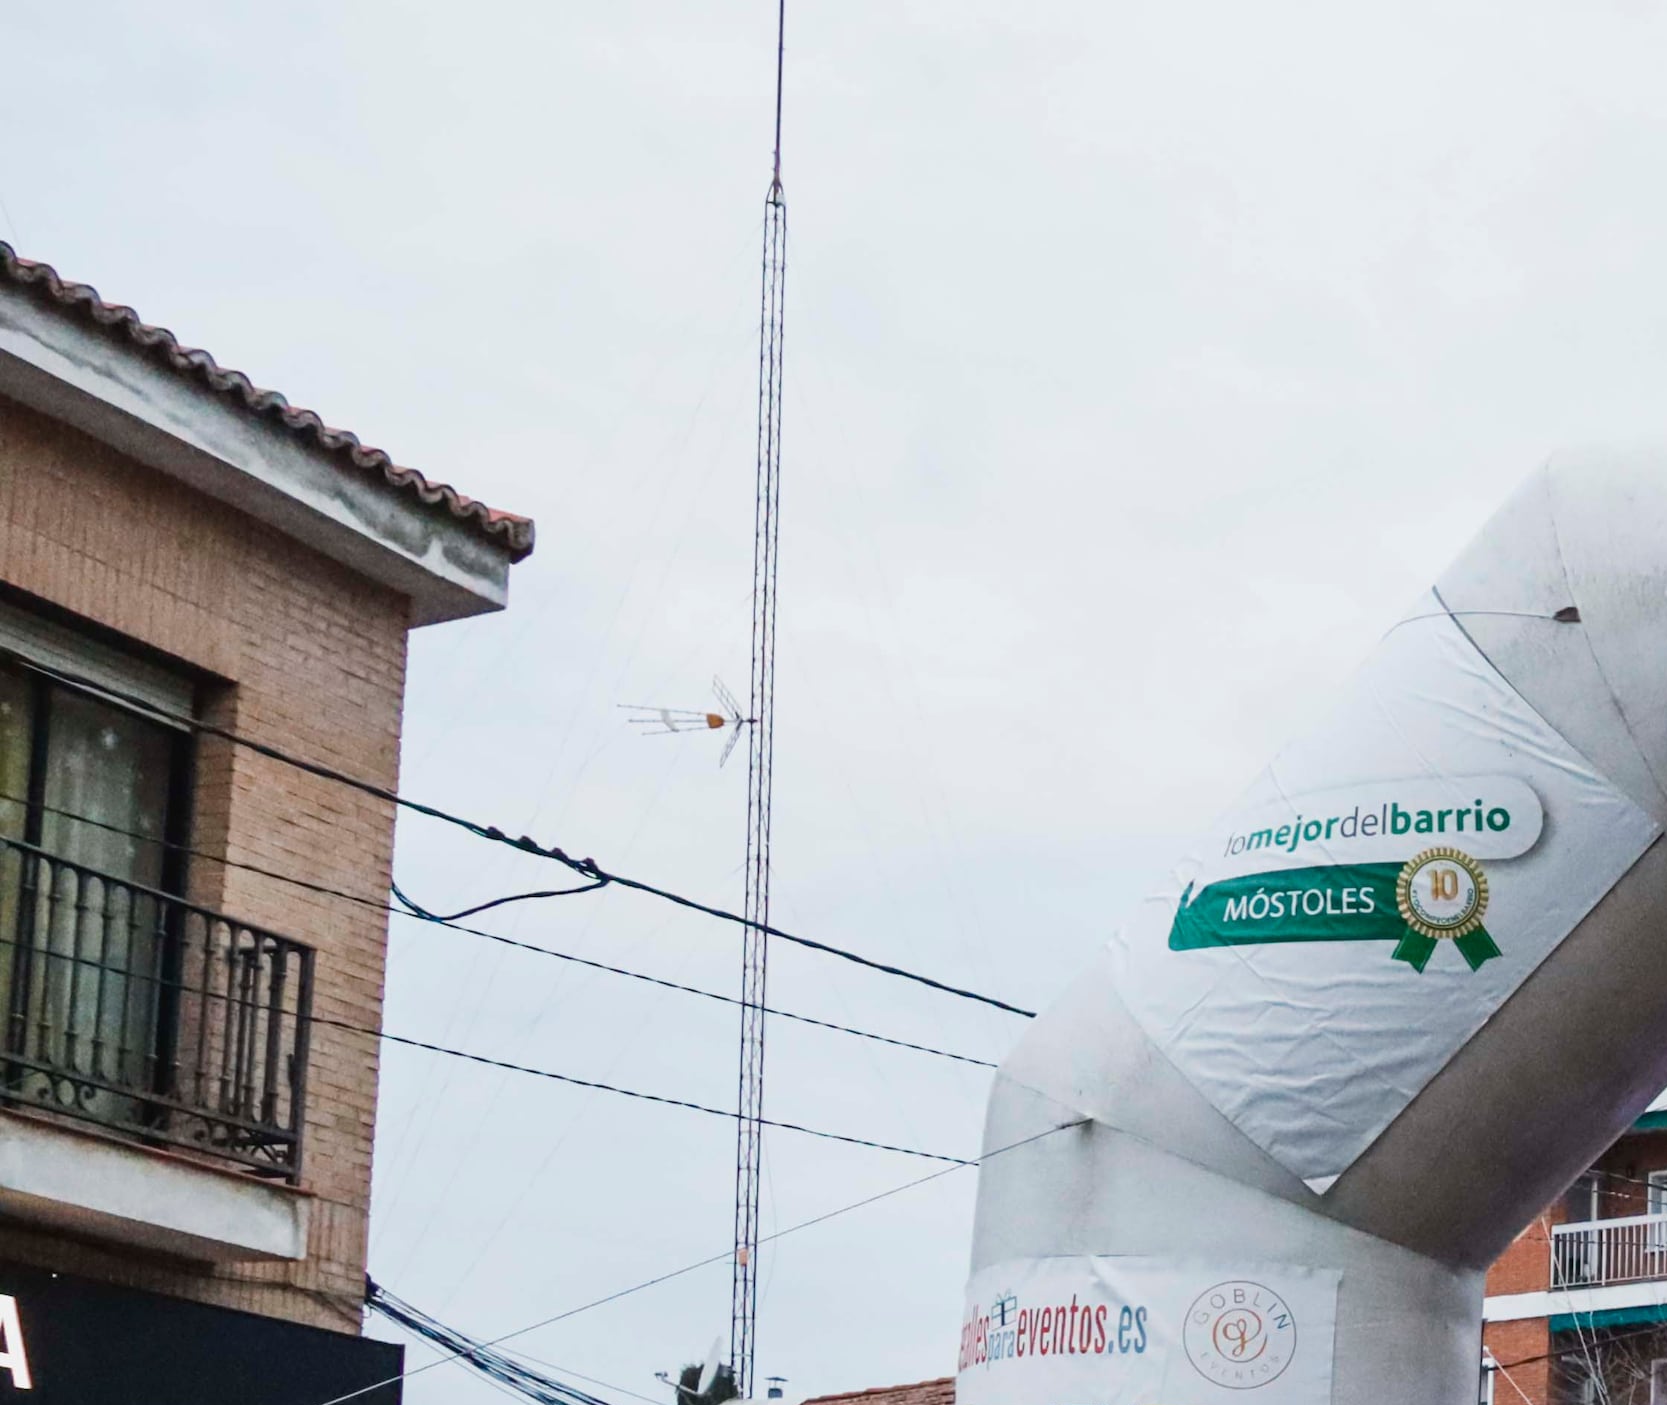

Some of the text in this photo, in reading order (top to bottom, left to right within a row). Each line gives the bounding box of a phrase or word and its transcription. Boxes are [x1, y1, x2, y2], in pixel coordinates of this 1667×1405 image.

[1223, 799, 1511, 858] lomejordelbarrio
[1223, 886, 1376, 923] MÓSTOLES
[1427, 869, 1459, 902] 10
[1193, 1288, 1291, 1329] GOBLIN
[0, 1293, 32, 1390] A
